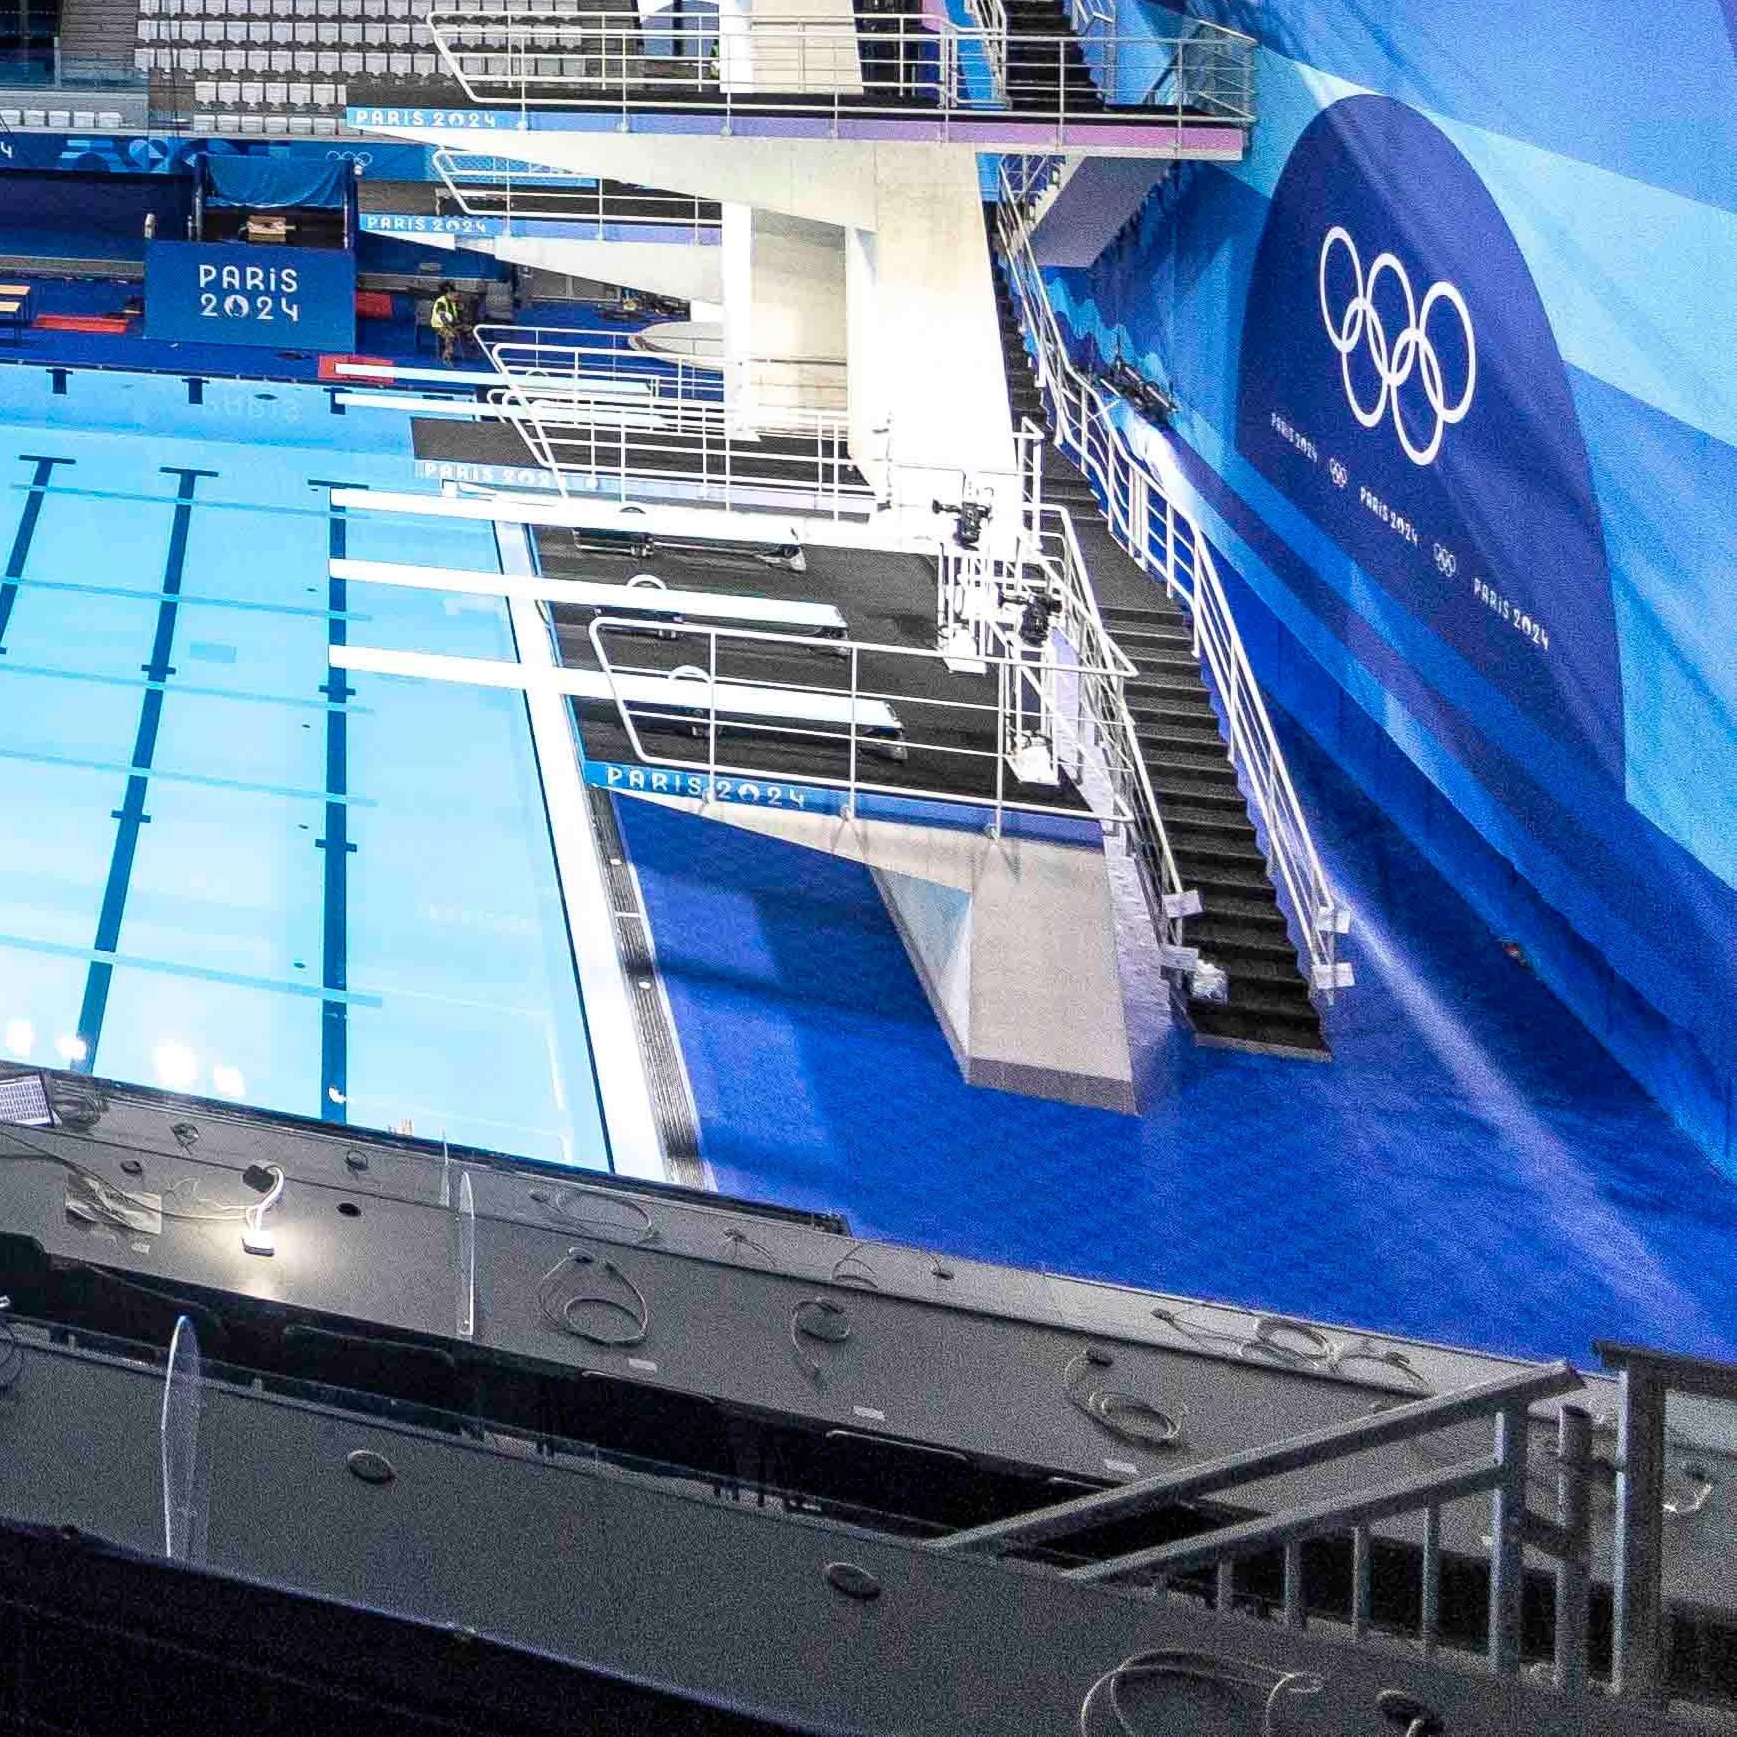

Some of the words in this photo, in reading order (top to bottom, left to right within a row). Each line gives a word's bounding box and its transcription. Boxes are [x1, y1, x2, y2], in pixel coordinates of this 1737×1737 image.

[432, 112, 496, 128] 2024
[432, 216, 487, 232] 2024
[200, 293, 299, 322] 2024
[1390, 511, 1418, 547] 2024
[1513, 608, 1550, 651] 2024
[716, 780, 805, 809] 2024
